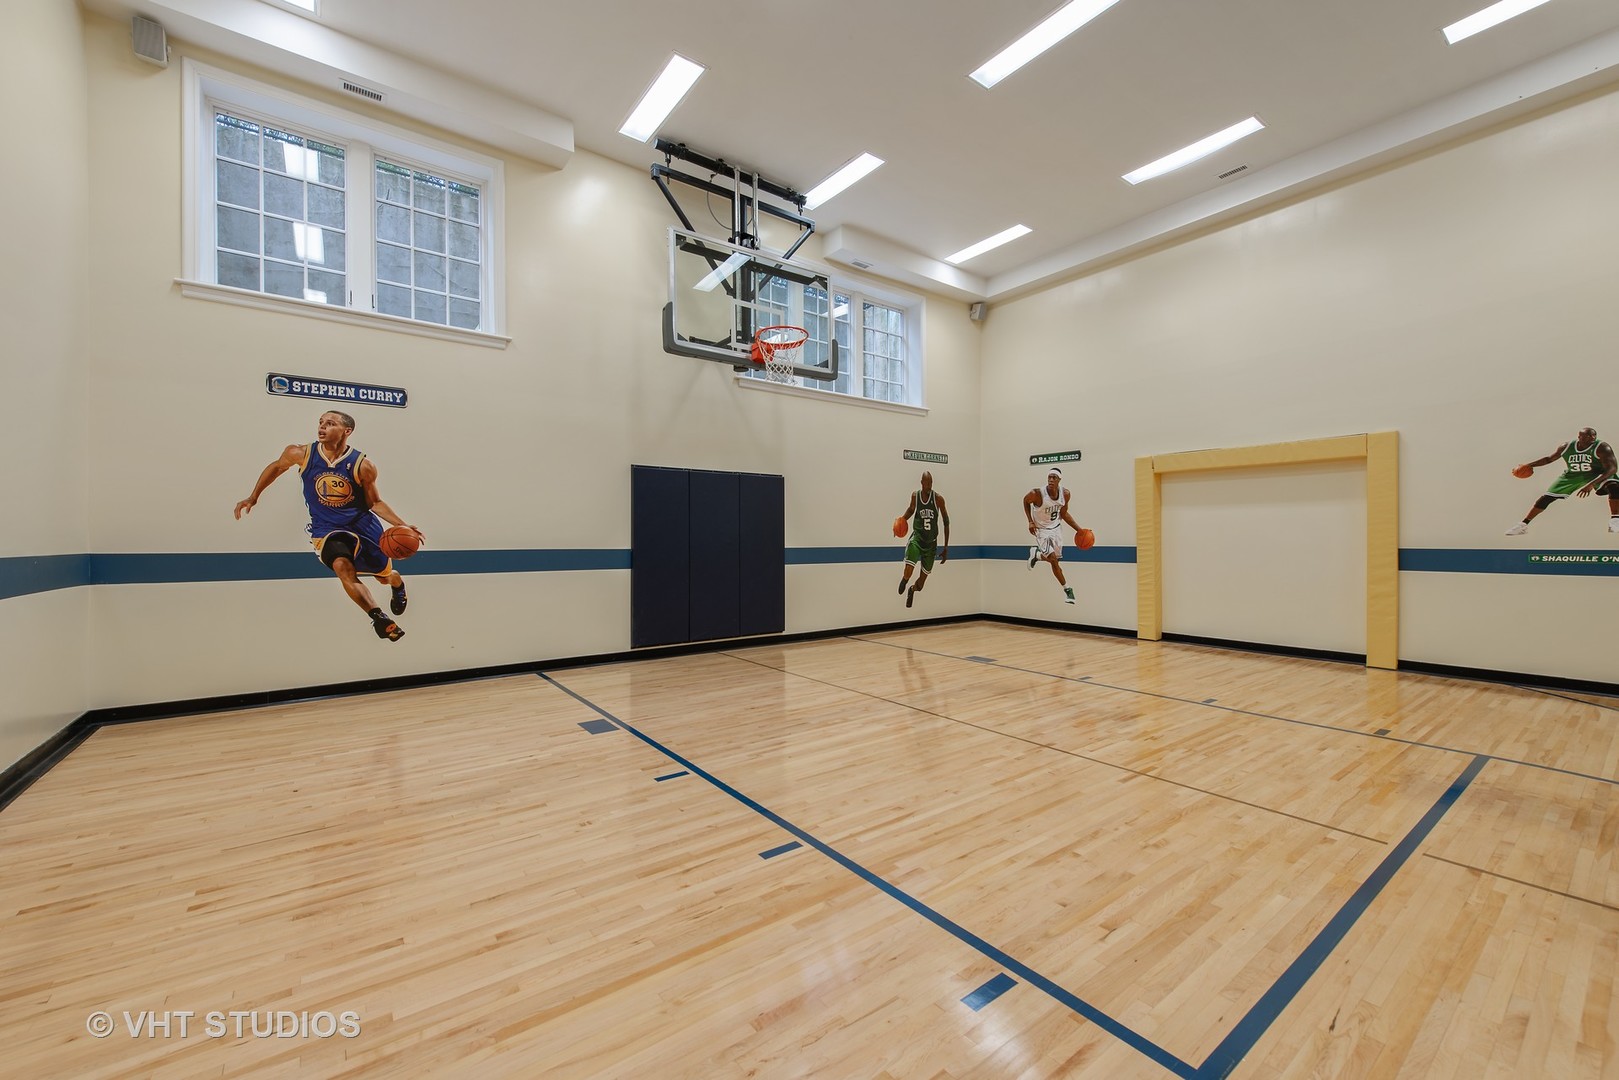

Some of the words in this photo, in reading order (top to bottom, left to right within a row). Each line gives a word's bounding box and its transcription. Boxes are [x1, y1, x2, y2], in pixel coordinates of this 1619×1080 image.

[292, 381, 356, 398] STEPHEN
[359, 388, 404, 403] CURRY
[1568, 453, 1593, 464] CELTICS
[1570, 462, 1592, 472] 36
[331, 480, 345, 488] 30
[1050, 511, 1058, 521] 9
[923, 518, 931, 531] 5
[1541, 555, 1599, 563] SHAQUILLE
